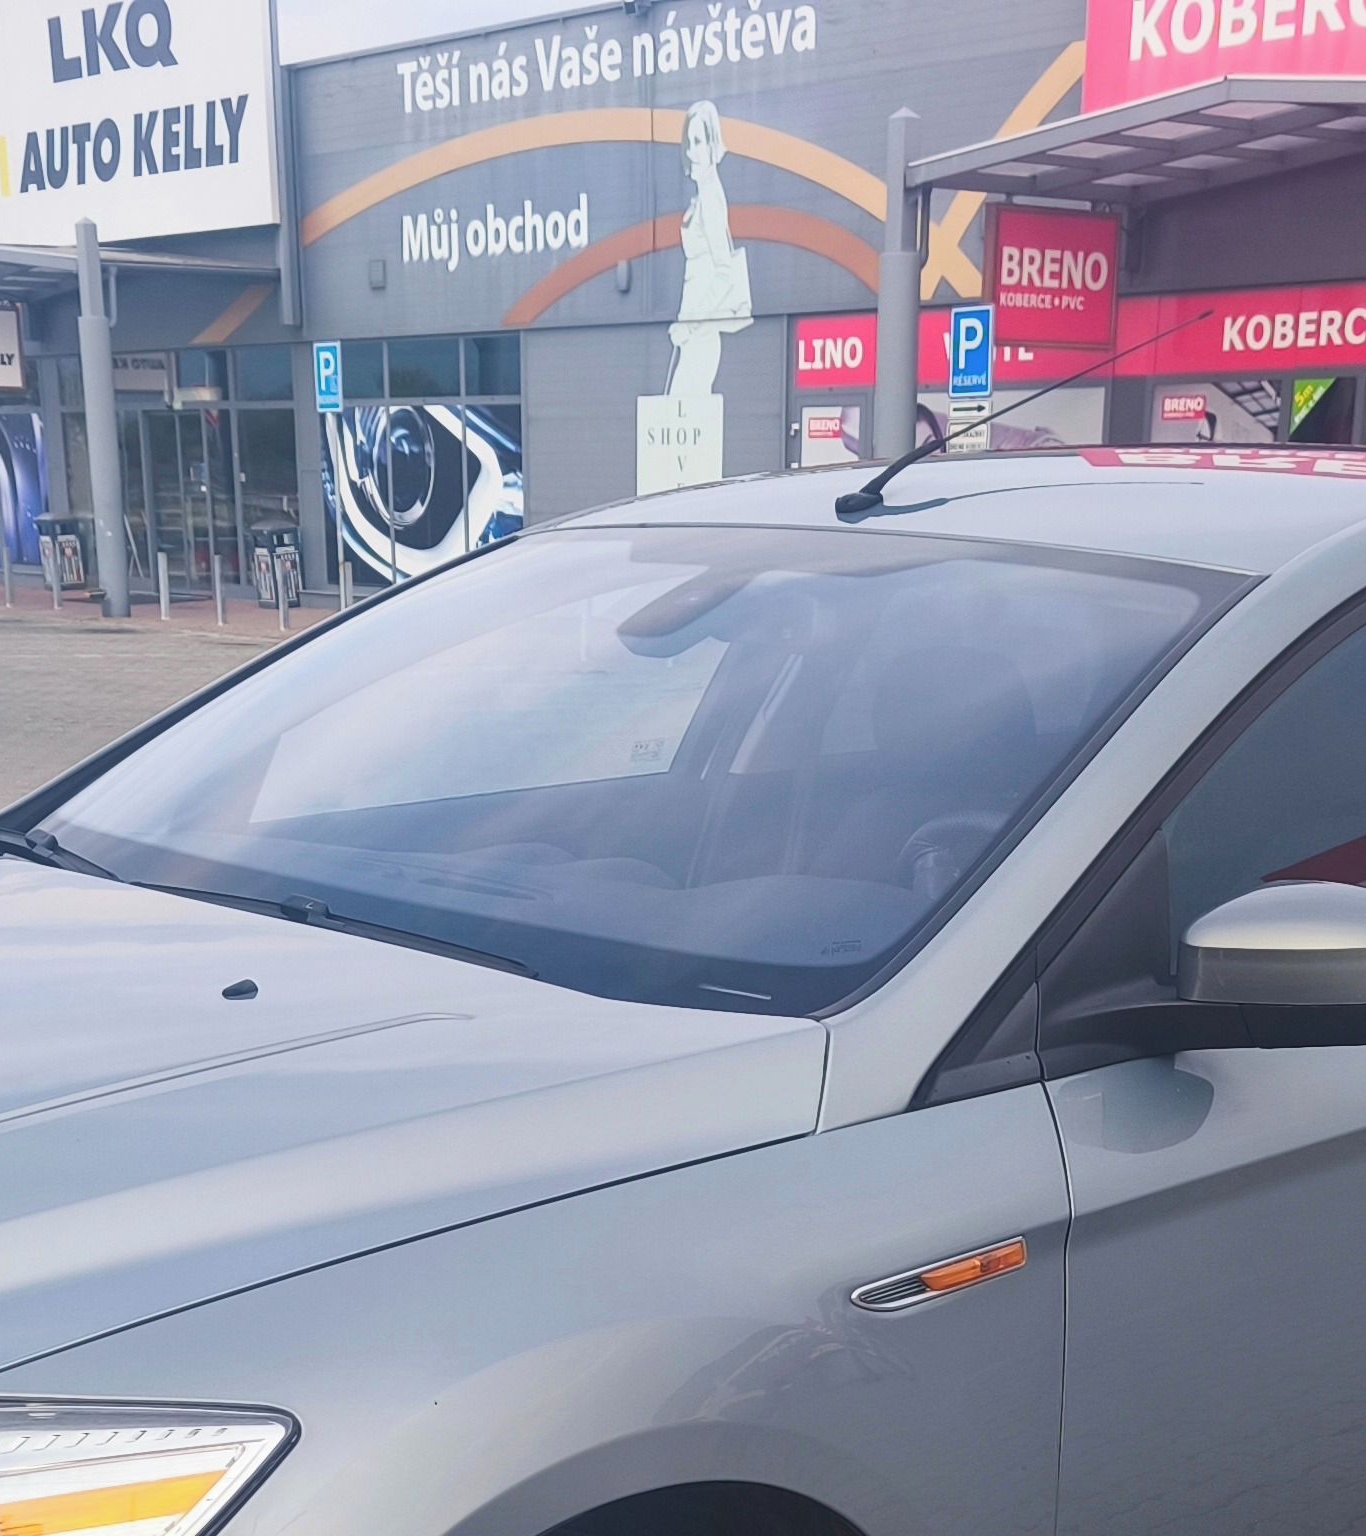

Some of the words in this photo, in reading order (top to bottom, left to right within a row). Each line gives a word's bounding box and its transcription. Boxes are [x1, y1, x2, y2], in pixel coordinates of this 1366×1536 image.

[46, 0, 179, 83] LKQ
[397, 50, 460, 113] Těší
[469, 42, 529, 104] nás
[534, 25, 623, 92] Vaše
[633, 0, 817, 77] návštěva
[19, 117, 121, 194] AUTO
[132, 94, 250, 178] KELLY
[402, 211, 460, 272] Můj
[466, 193, 589, 257] obchod
[1000, 245, 1108, 292] BRENO
[797, 336, 863, 372] LINO
[959, 318, 984, 369] P
[319, 351, 335, 391] P
[647, 427, 701, 445] SHOP
